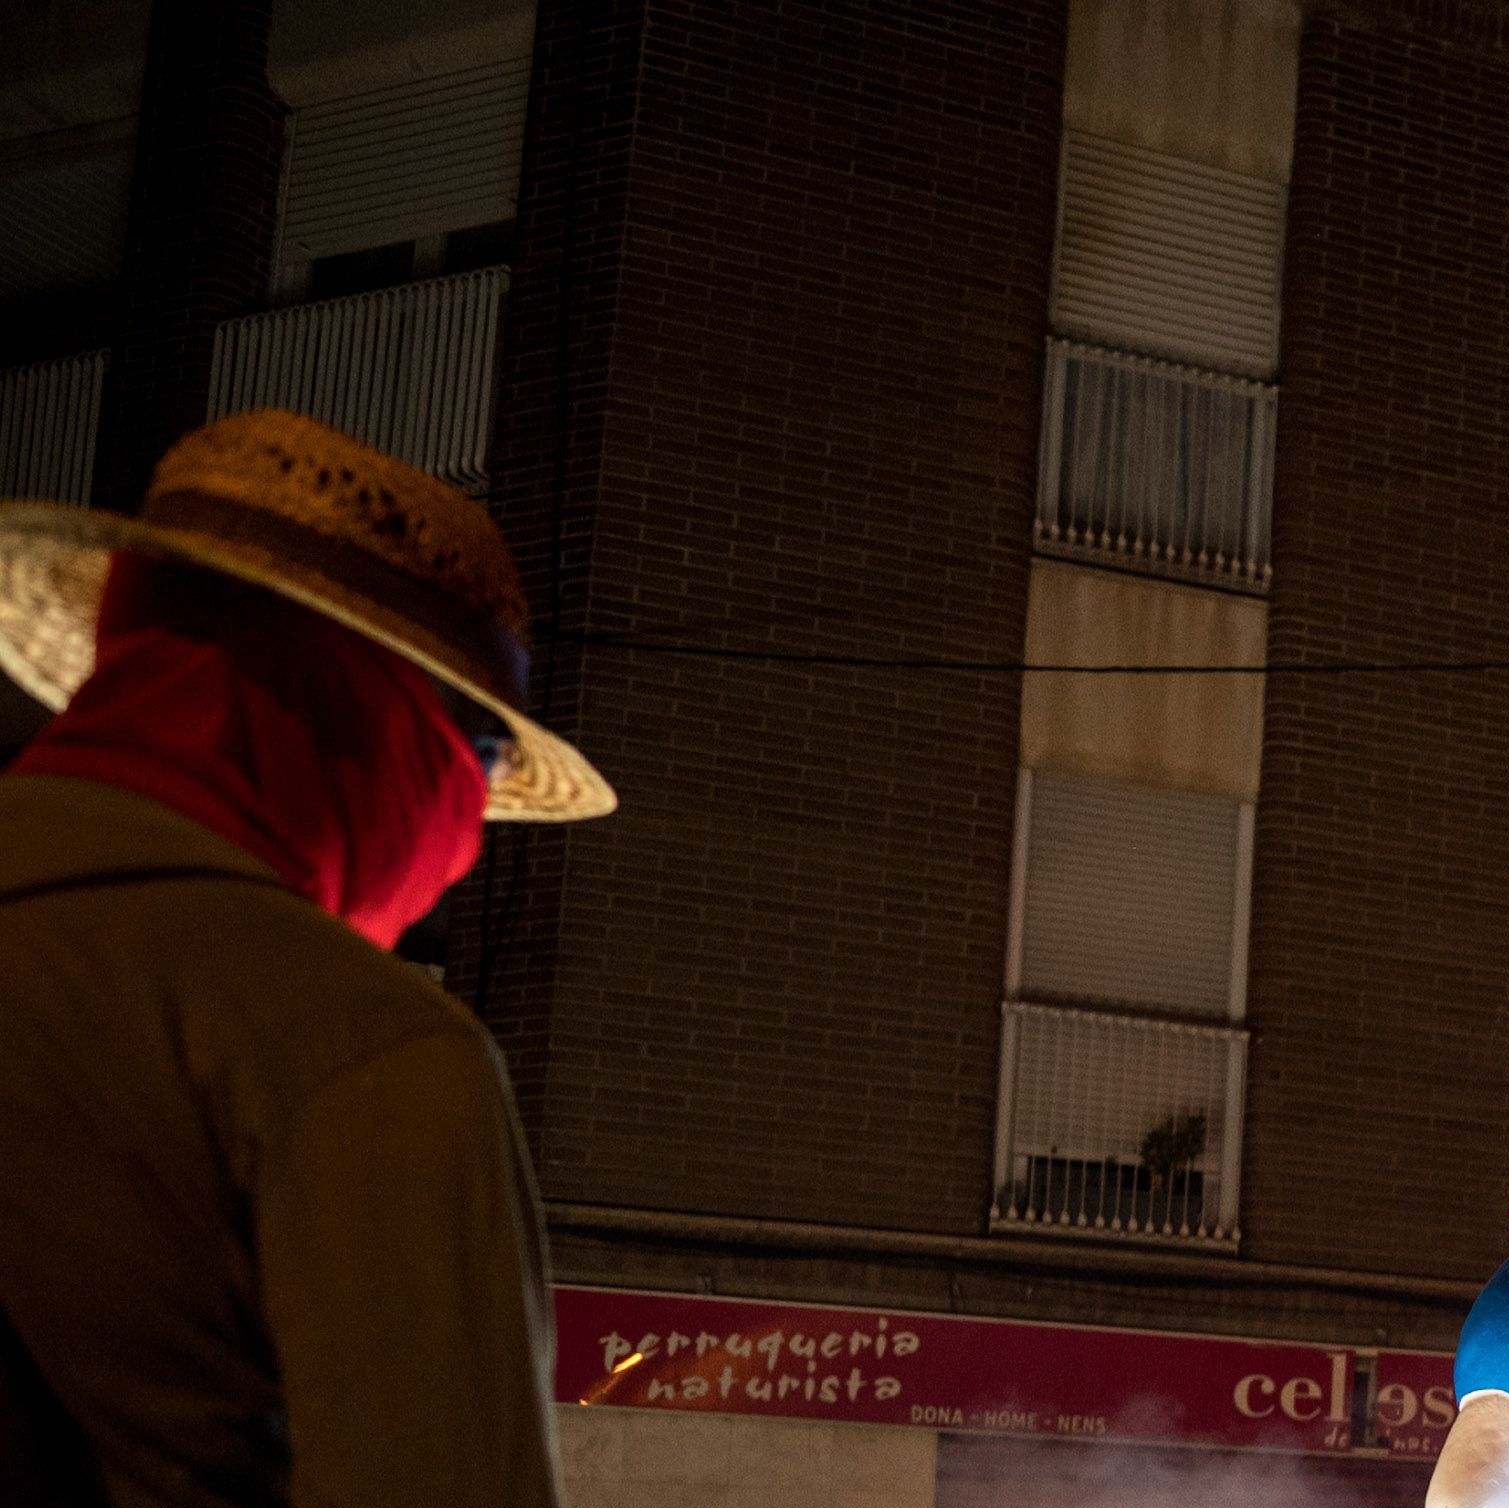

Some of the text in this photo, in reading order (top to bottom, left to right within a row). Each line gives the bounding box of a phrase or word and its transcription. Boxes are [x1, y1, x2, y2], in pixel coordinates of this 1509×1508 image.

[598, 1316, 920, 1372] perruqueria
[647, 1359, 902, 1402] naturista
[910, 1404, 964, 1425] DONA
[983, 1409, 1038, 1430] HOME
